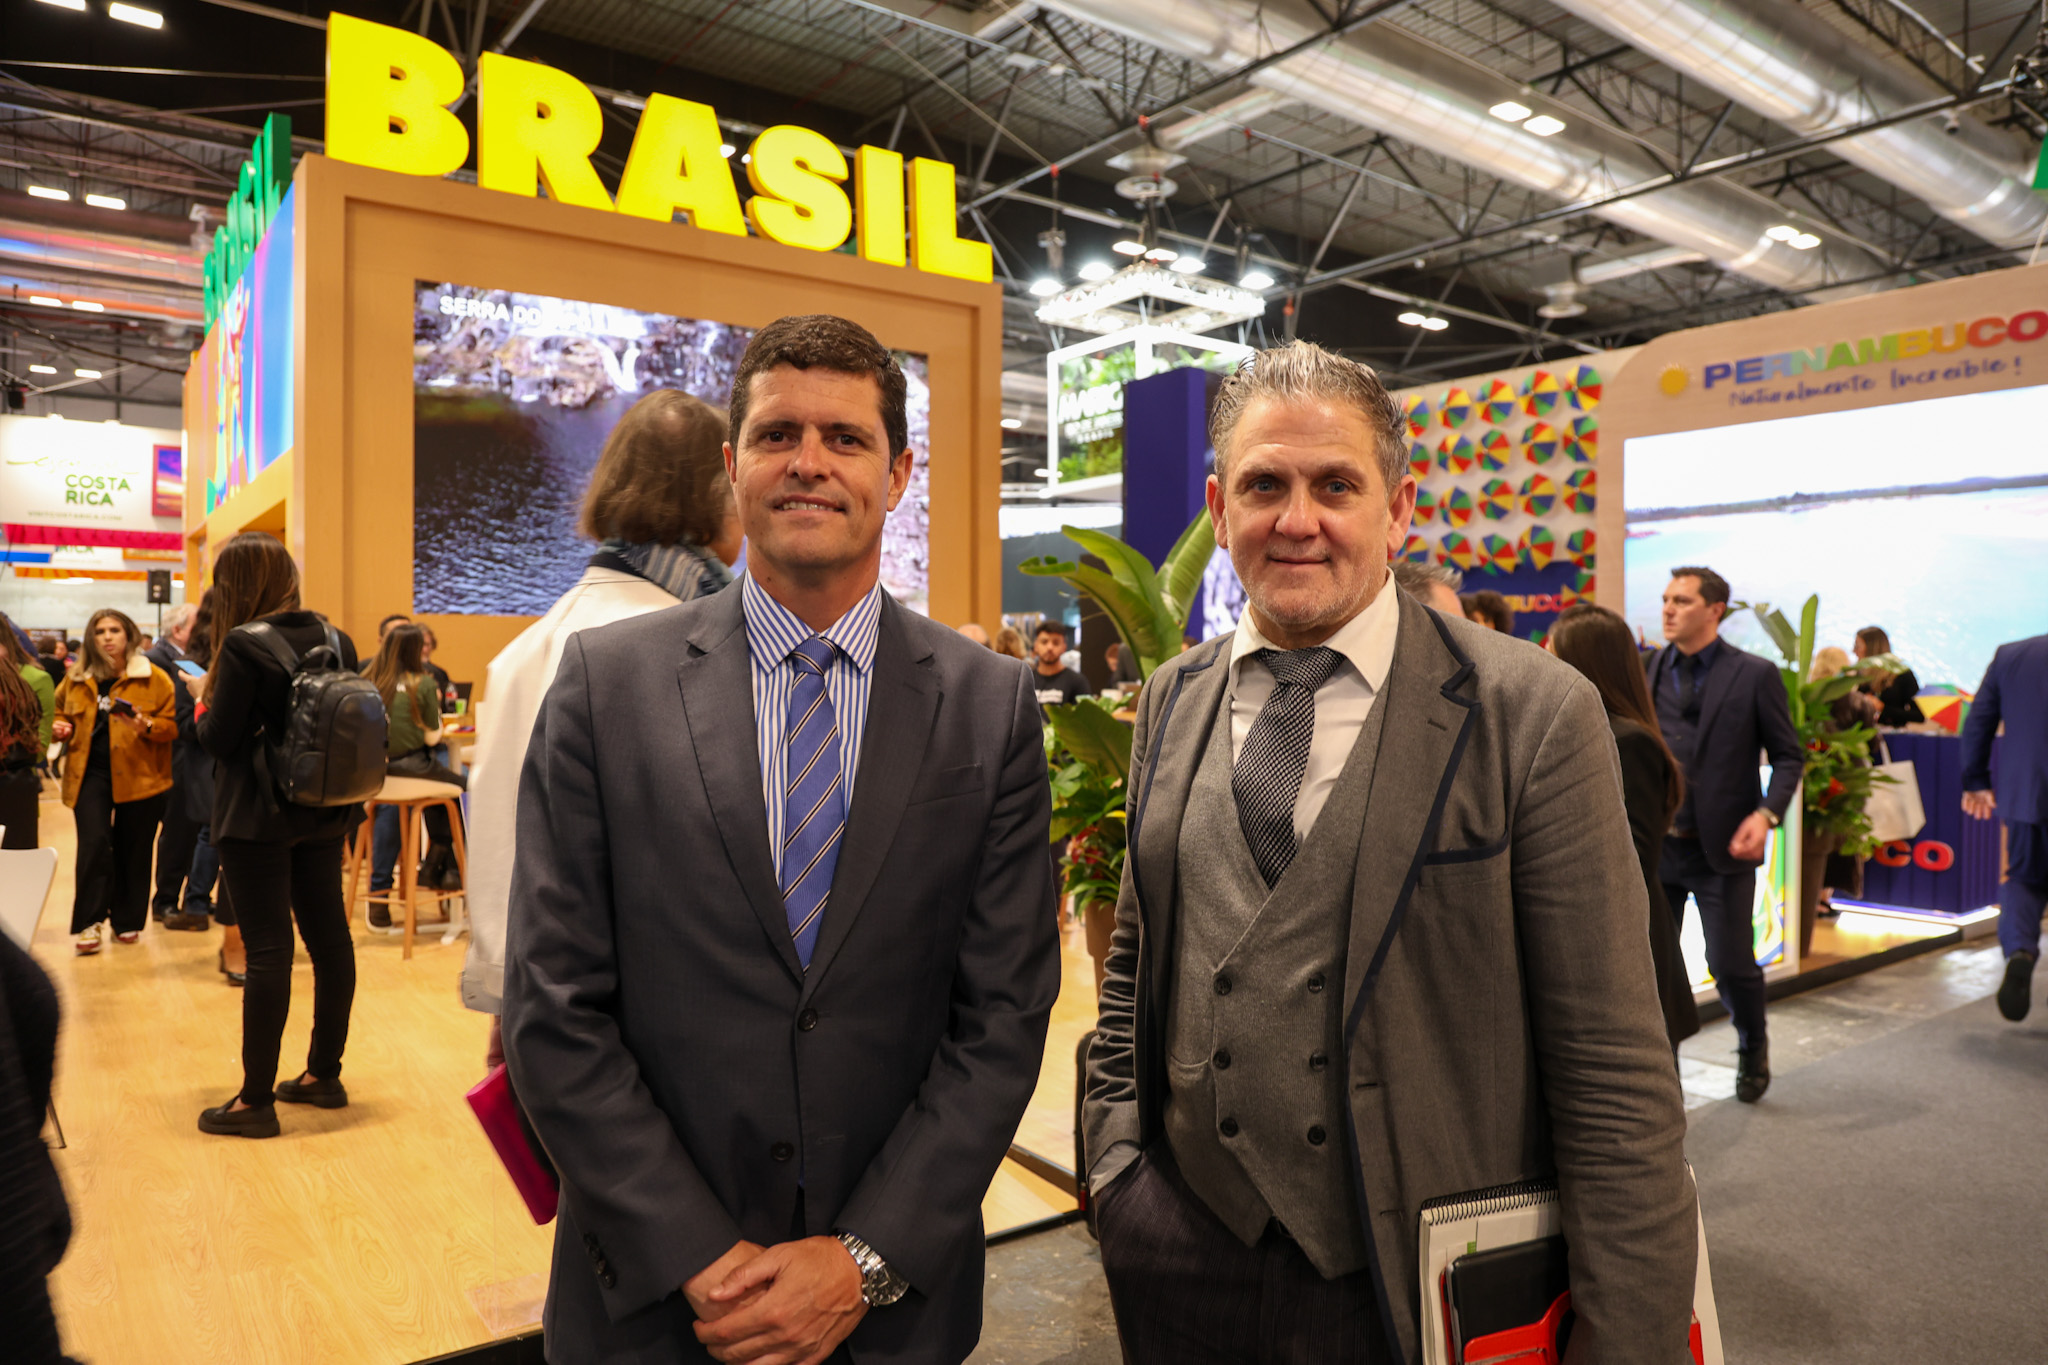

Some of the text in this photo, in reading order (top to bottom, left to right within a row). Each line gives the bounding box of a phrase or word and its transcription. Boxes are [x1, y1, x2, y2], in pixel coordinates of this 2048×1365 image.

[325, 11, 993, 283] BRASIL
[439, 294, 510, 323] SERRA
[512, 306, 542, 327] DO
[1703, 309, 2048, 390] PERNAMBUCO
[1729, 373, 1876, 407] Naturalmente
[65, 474, 132, 492] COSTA
[65, 489, 114, 507] RICA
